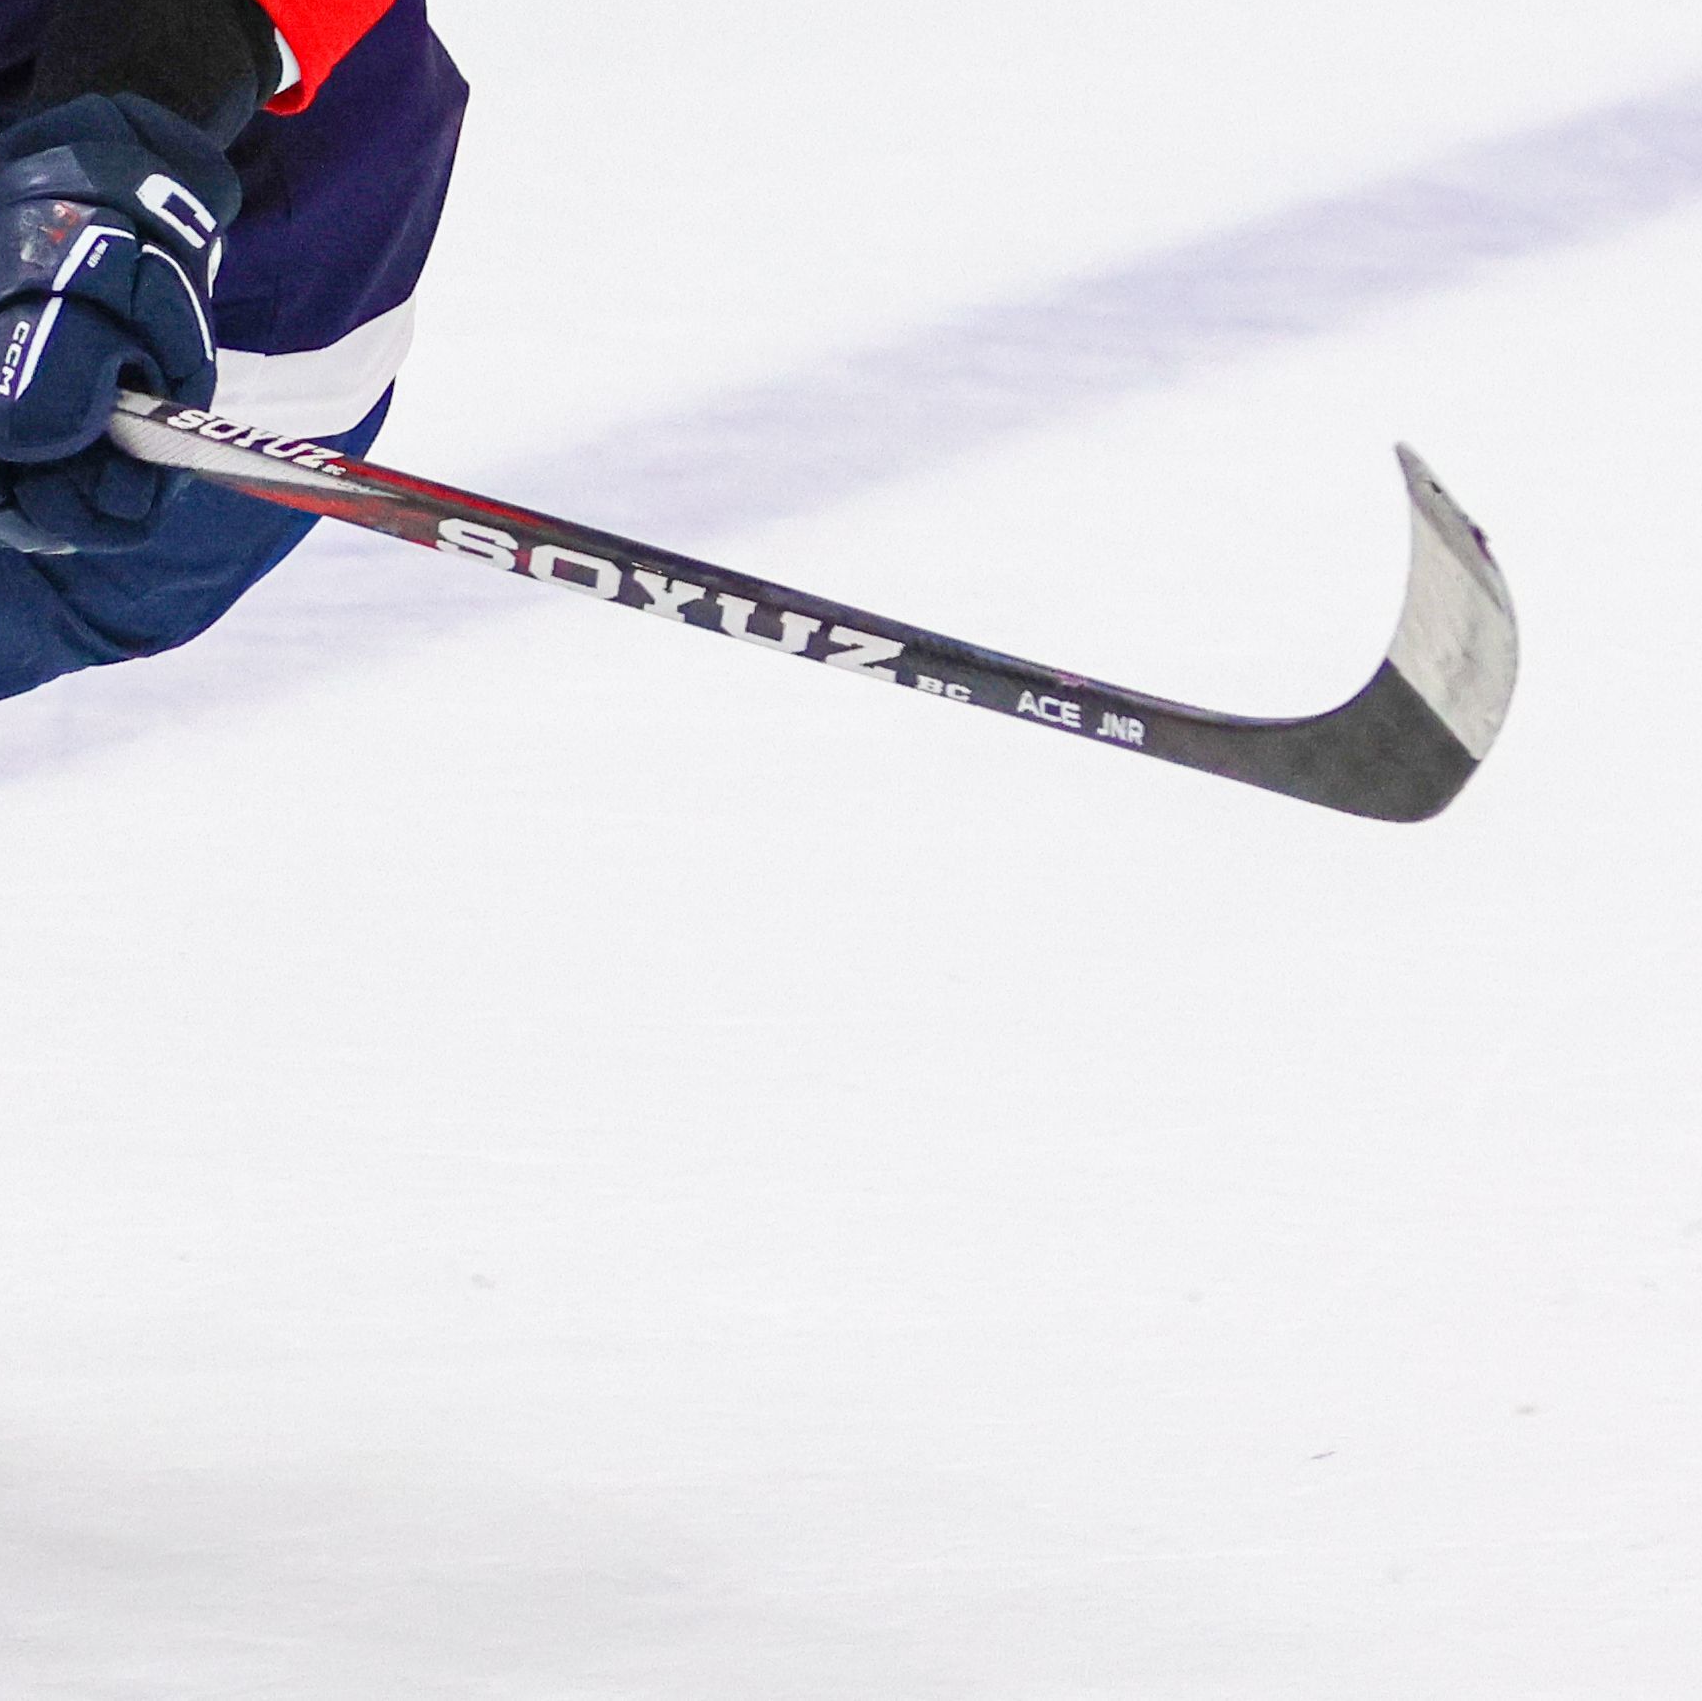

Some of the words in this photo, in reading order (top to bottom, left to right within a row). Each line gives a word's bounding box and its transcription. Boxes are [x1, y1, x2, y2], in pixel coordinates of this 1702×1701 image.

[167, 408, 345, 474] SOYUZ
[435, 516, 907, 686] SOYUZ
[915, 674, 973, 706] BC
[1016, 689, 1083, 731] ACE
[1095, 710, 1146, 749] JNR
